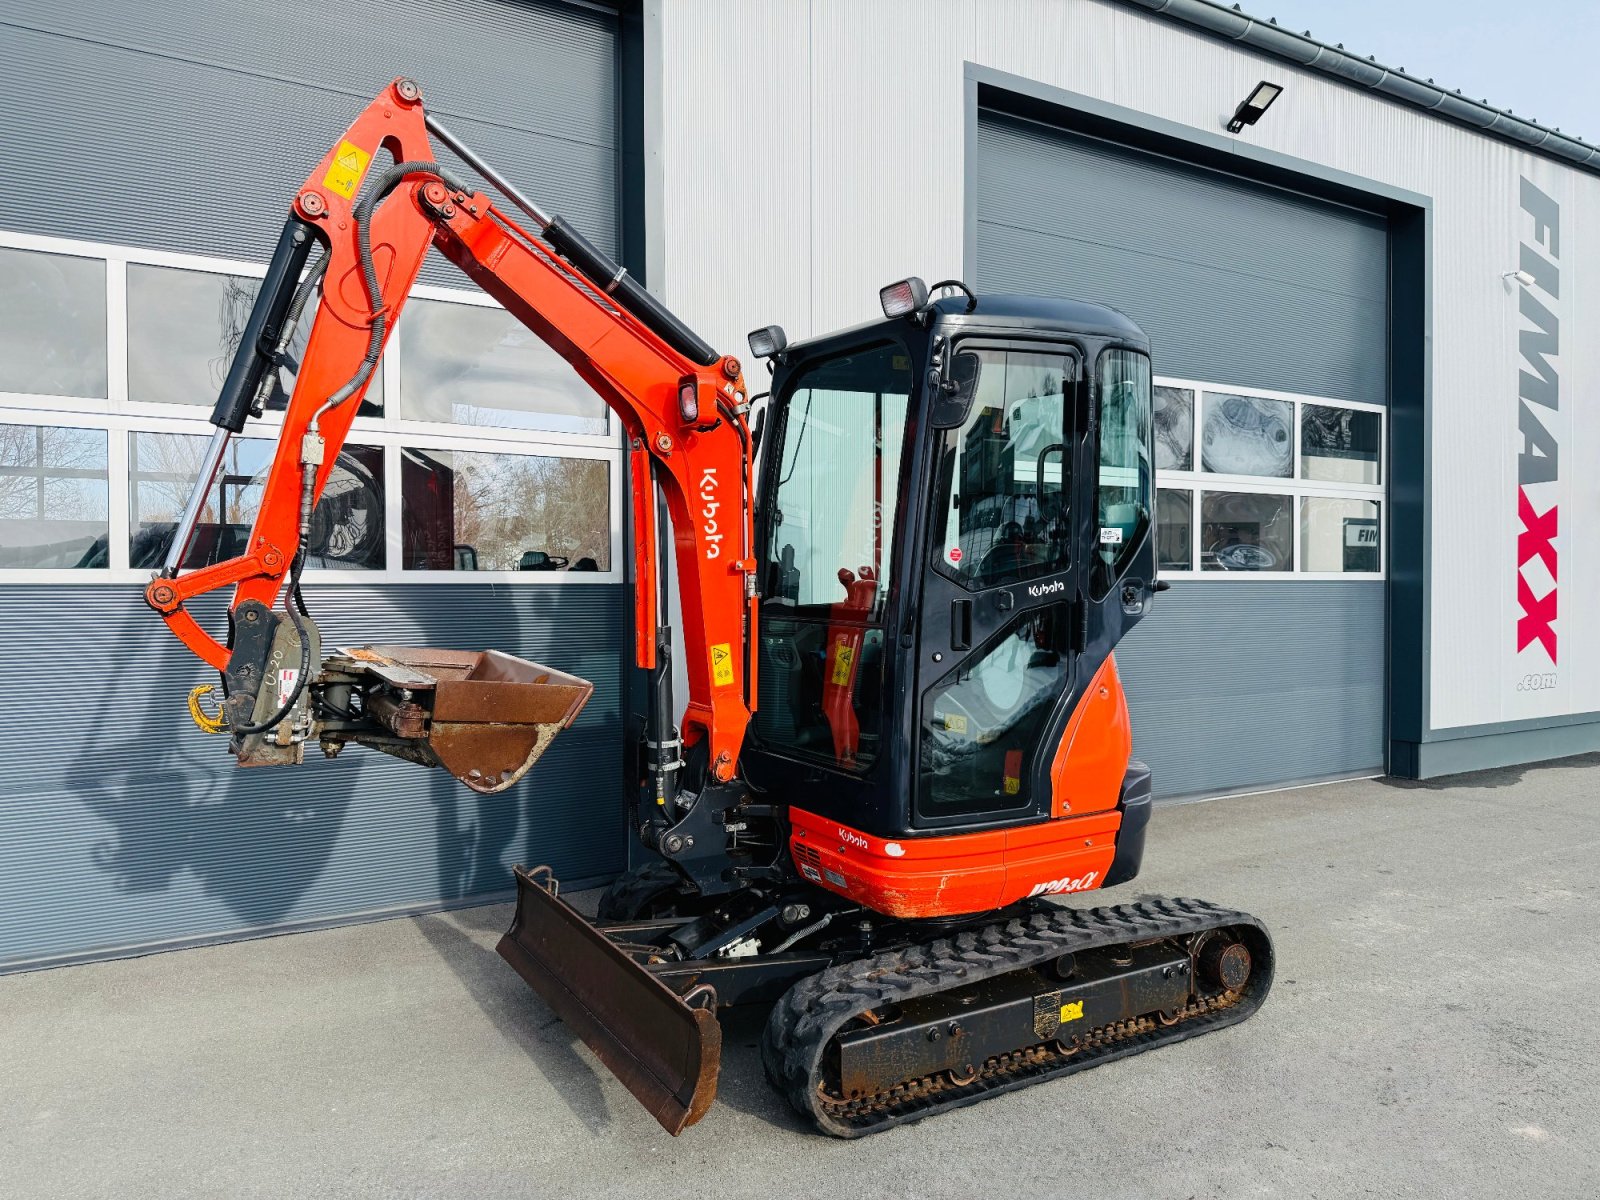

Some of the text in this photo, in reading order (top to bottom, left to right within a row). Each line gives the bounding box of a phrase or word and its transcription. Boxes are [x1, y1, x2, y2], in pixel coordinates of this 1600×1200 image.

[1517, 174, 1560, 667] FIMAXX
[699, 468, 724, 560] Kubota
[1028, 579, 1065, 598] Kubota
[838, 827, 869, 850] Kubota
